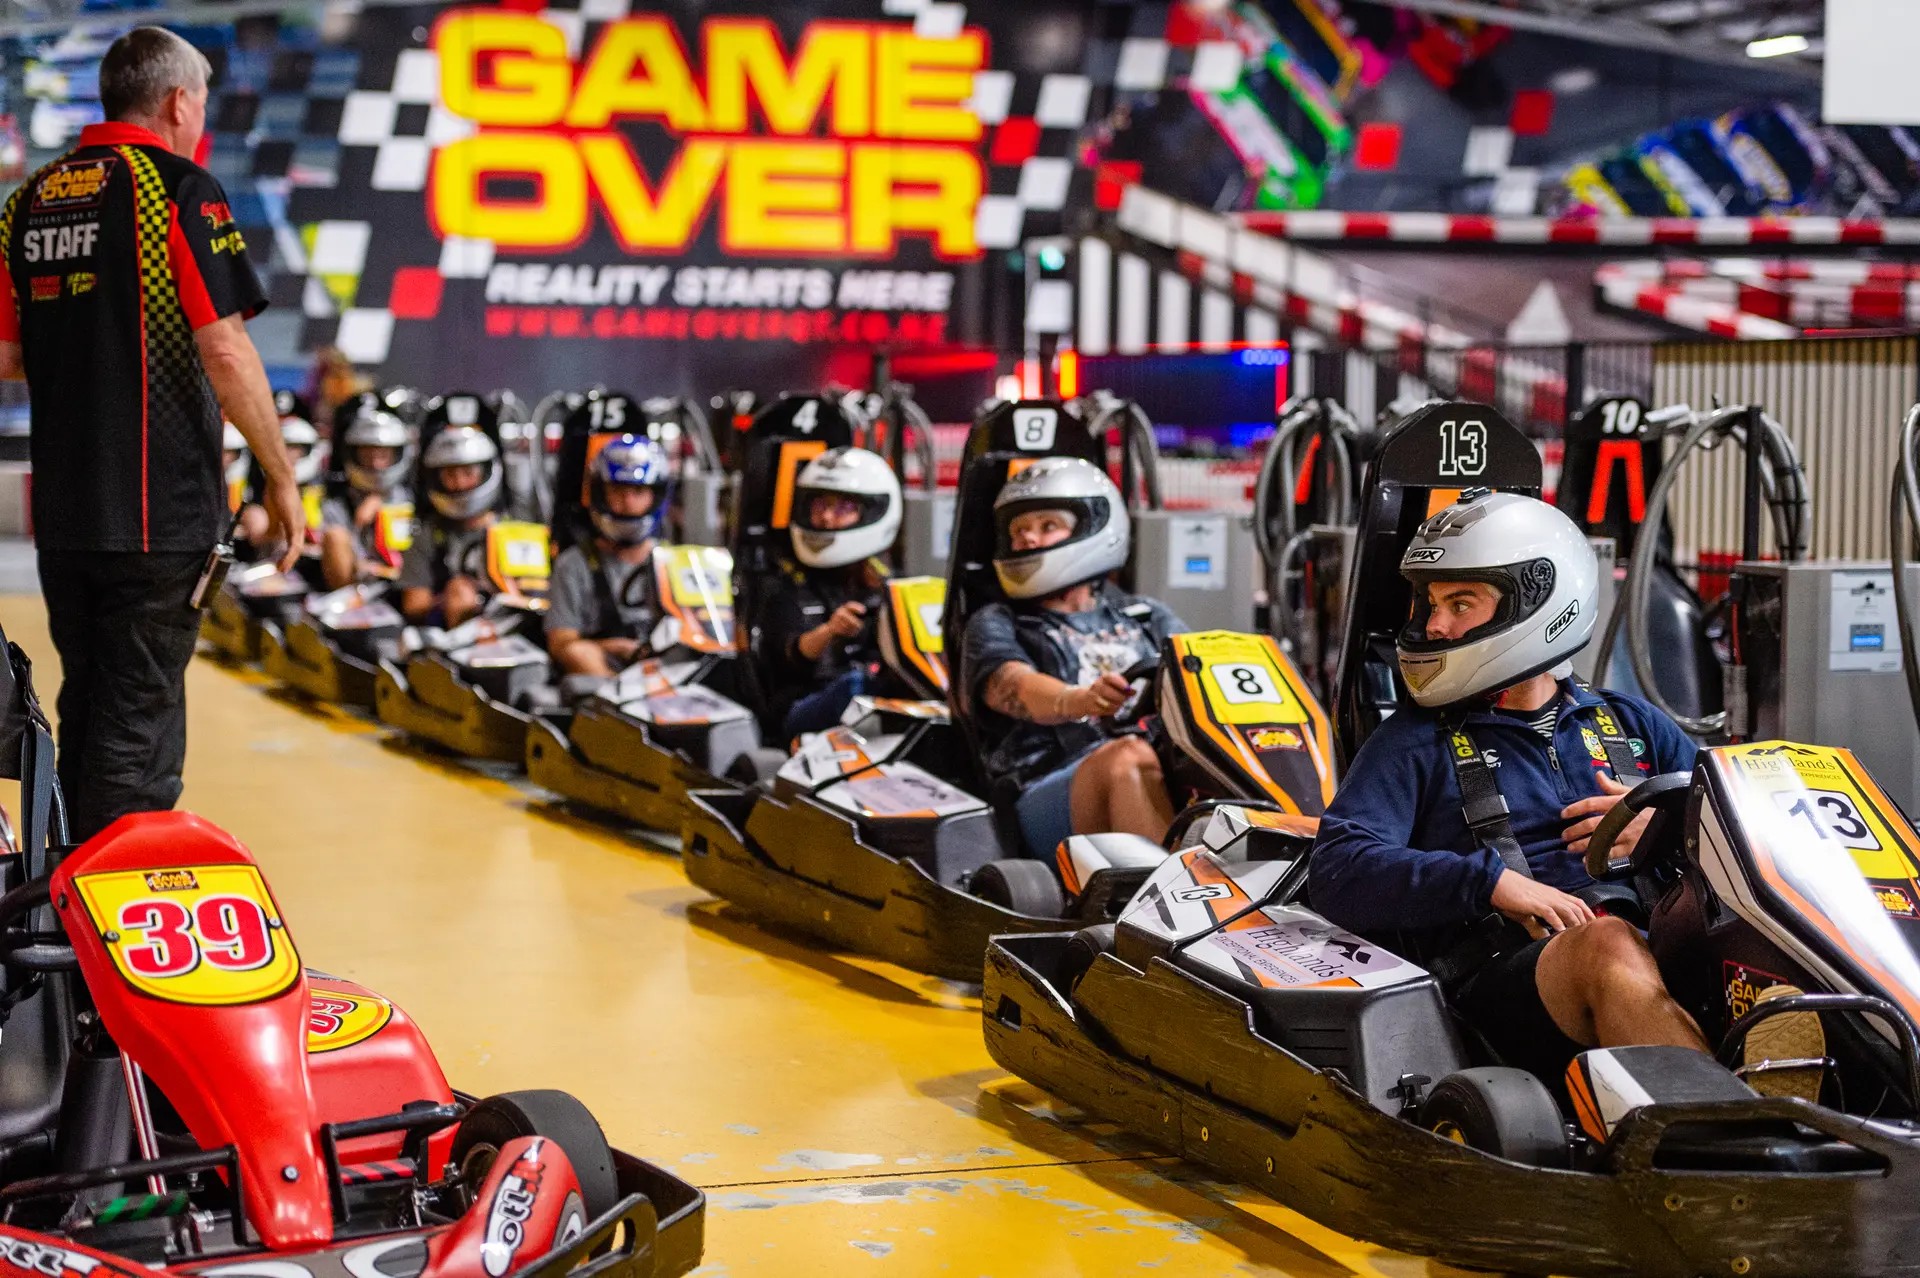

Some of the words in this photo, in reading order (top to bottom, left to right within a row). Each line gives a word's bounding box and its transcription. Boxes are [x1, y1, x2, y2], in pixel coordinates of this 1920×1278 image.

[432, 11, 988, 140] GAME
[40, 181, 101, 200] OVER
[46, 167, 105, 187] GAME
[429, 134, 984, 259] OVER
[23, 222, 100, 263] STAFF
[485, 262, 671, 305] REALITY
[672, 265, 834, 309] STARTS
[836, 269, 955, 311] HERE
[588, 398, 626, 430] 15
[791, 400, 819, 434] 4
[1025, 416, 1046, 442] 8
[1602, 401, 1640, 434] 10
[1439, 421, 1488, 476] 13
[1231, 668, 1263, 694] 8
[1744, 756, 1836, 772] Higlands
[1788, 796, 1868, 841] 13
[1180, 886, 1221, 900] 13
[118, 893, 276, 979] 39
[1247, 927, 1345, 980] Highlands
